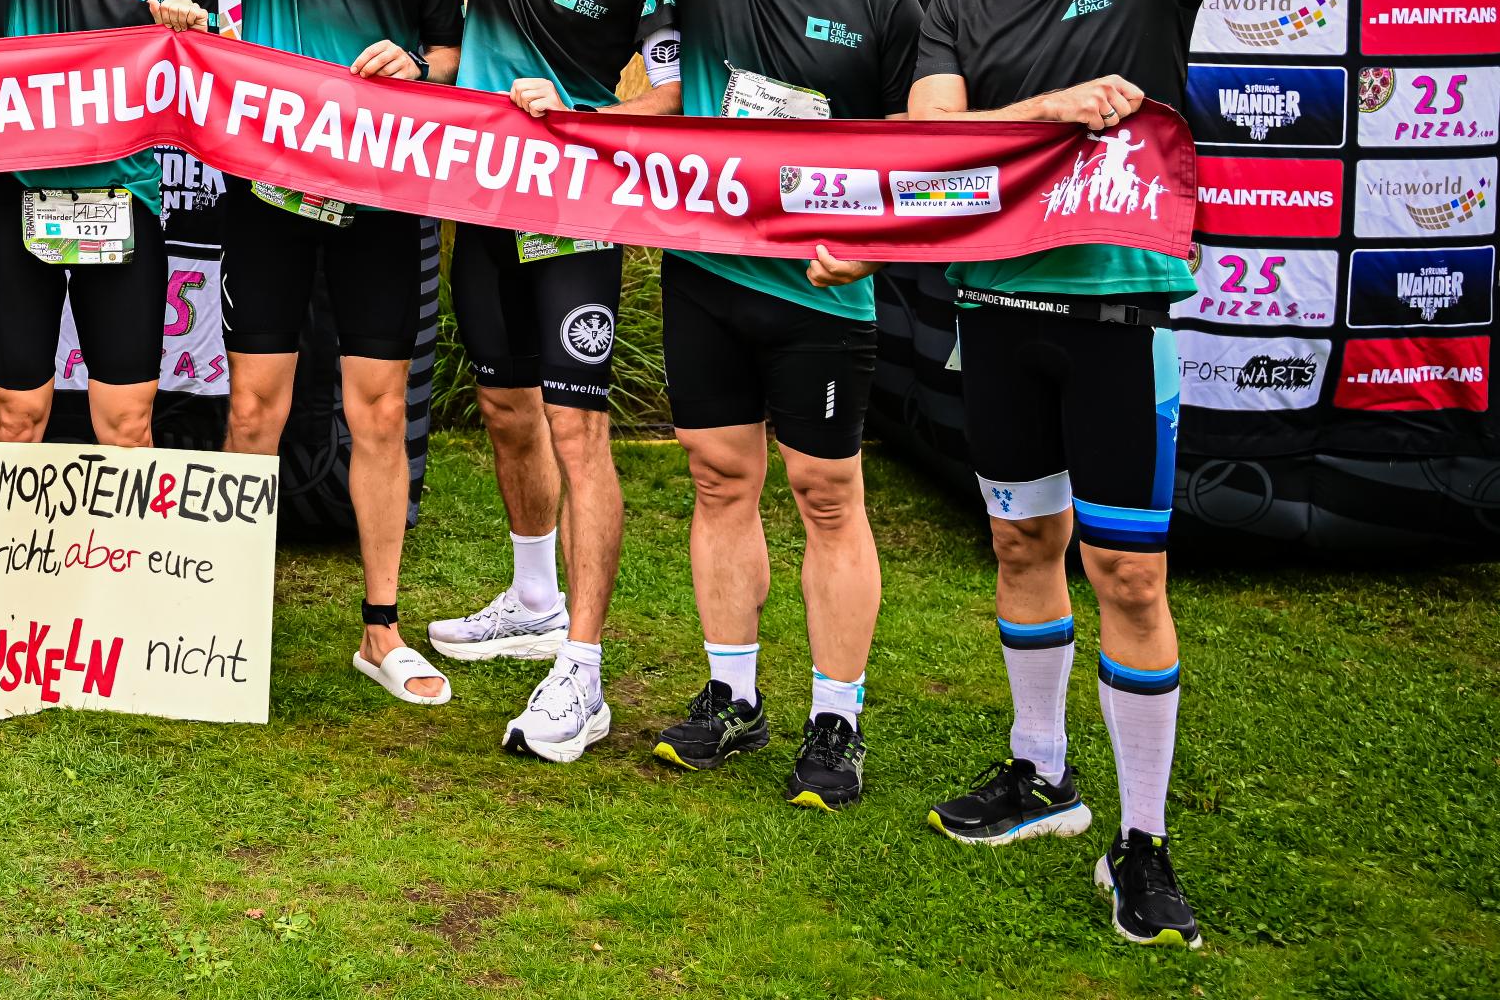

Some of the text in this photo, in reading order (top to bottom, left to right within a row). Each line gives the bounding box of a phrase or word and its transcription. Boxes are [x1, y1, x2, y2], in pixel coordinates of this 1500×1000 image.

[1078, 0, 1113, 16] SPACE.
[1391, 7, 1497, 25] MAINTRANS
[830, 28, 863, 43] CREATE
[831, 21, 847, 31] WE
[720, 71, 740, 118] RANKFURT
[1218, 89, 1302, 117] WANDER
[1411, 74, 1469, 116] 25
[1236, 115, 1283, 128] EVENT
[226, 79, 599, 202] FRANKFURT
[611, 149, 750, 218] 2026
[810, 172, 848, 198] 25
[896, 175, 993, 193] SPORTSTADT
[1366, 175, 1463, 196] vitaworld
[900, 200, 991, 208] FRANKFURT AM MAIN
[1197, 186, 1334, 208] MAINTRANS
[74, 204, 114, 220] ALEX
[76, 225, 108, 236] 1217
[1217, 254, 1287, 295] 25
[1397, 271, 1464, 298] WANDER
[1409, 296, 1451, 309] EVENT
[1178, 358, 1315, 384] PORTWÄRTS
[1370, 365, 1484, 385] MAINTRANS
[64, 528, 141, 573] aber
[148, 550, 215, 584] eure
[146, 635, 248, 684] nicht
